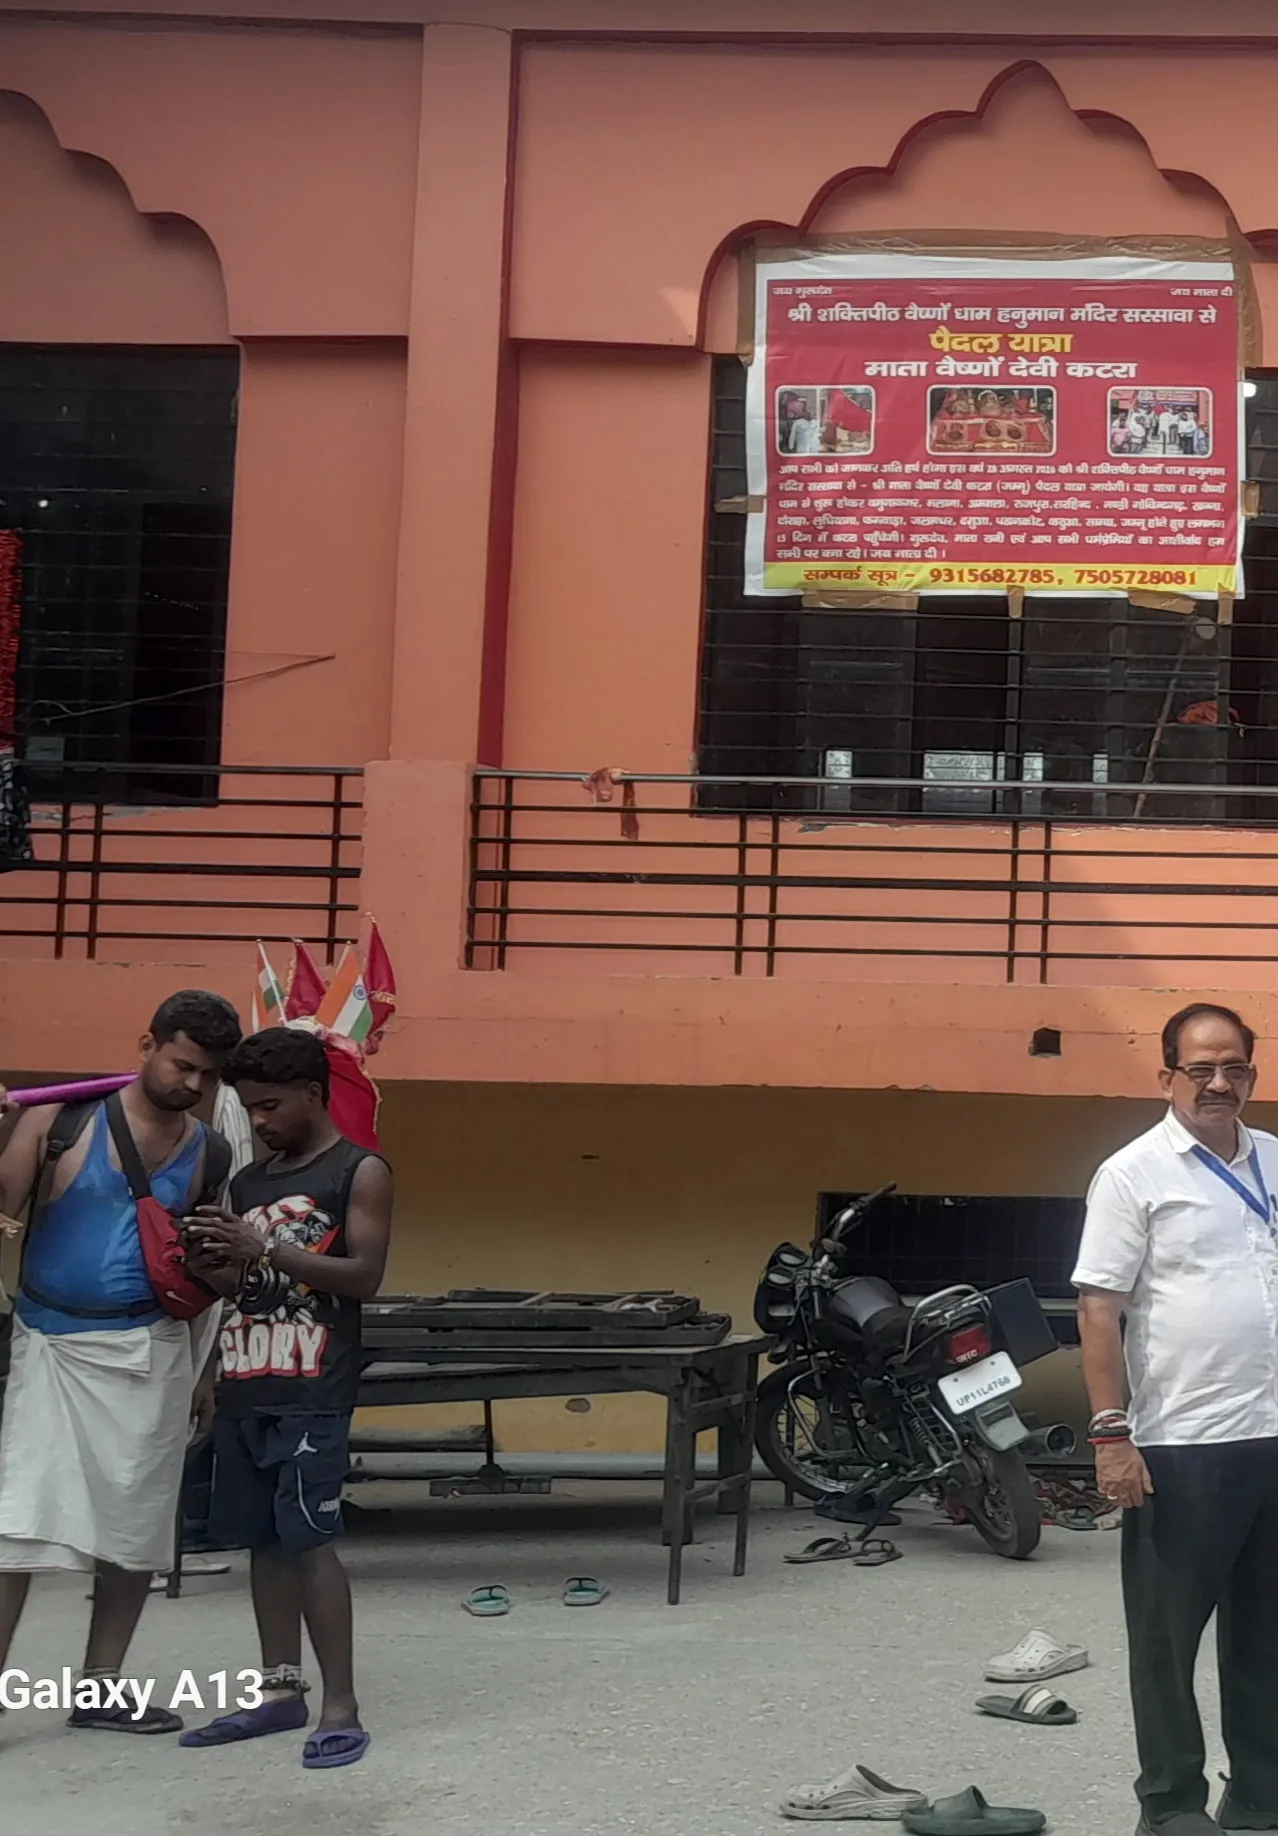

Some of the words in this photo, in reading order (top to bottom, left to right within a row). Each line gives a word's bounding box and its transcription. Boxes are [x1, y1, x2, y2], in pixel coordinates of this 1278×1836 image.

[787, 302, 812, 321] श्री
[816, 301, 901, 321] शक्तिपीठ
[954, 306, 992, 321] धाम
[997, 307, 1064, 328] हनुमान
[1198, 304, 1217, 324] से
[928, 325, 1002, 354] पैदल
[1008, 332, 1073, 353] यात्रा
[864, 361, 929, 377] माता
[1008, 355, 1059, 378] देवी
[1065, 362, 1138, 379] कटरा
[803, 566, 862, 581] सम्पर्क
[867, 569, 898, 587] सूत्र
[929, 567, 1064, 586] 9315682785,
[1074, 569, 1196, 585] 7505728081
[219, 1322, 328, 1379] GLORY
